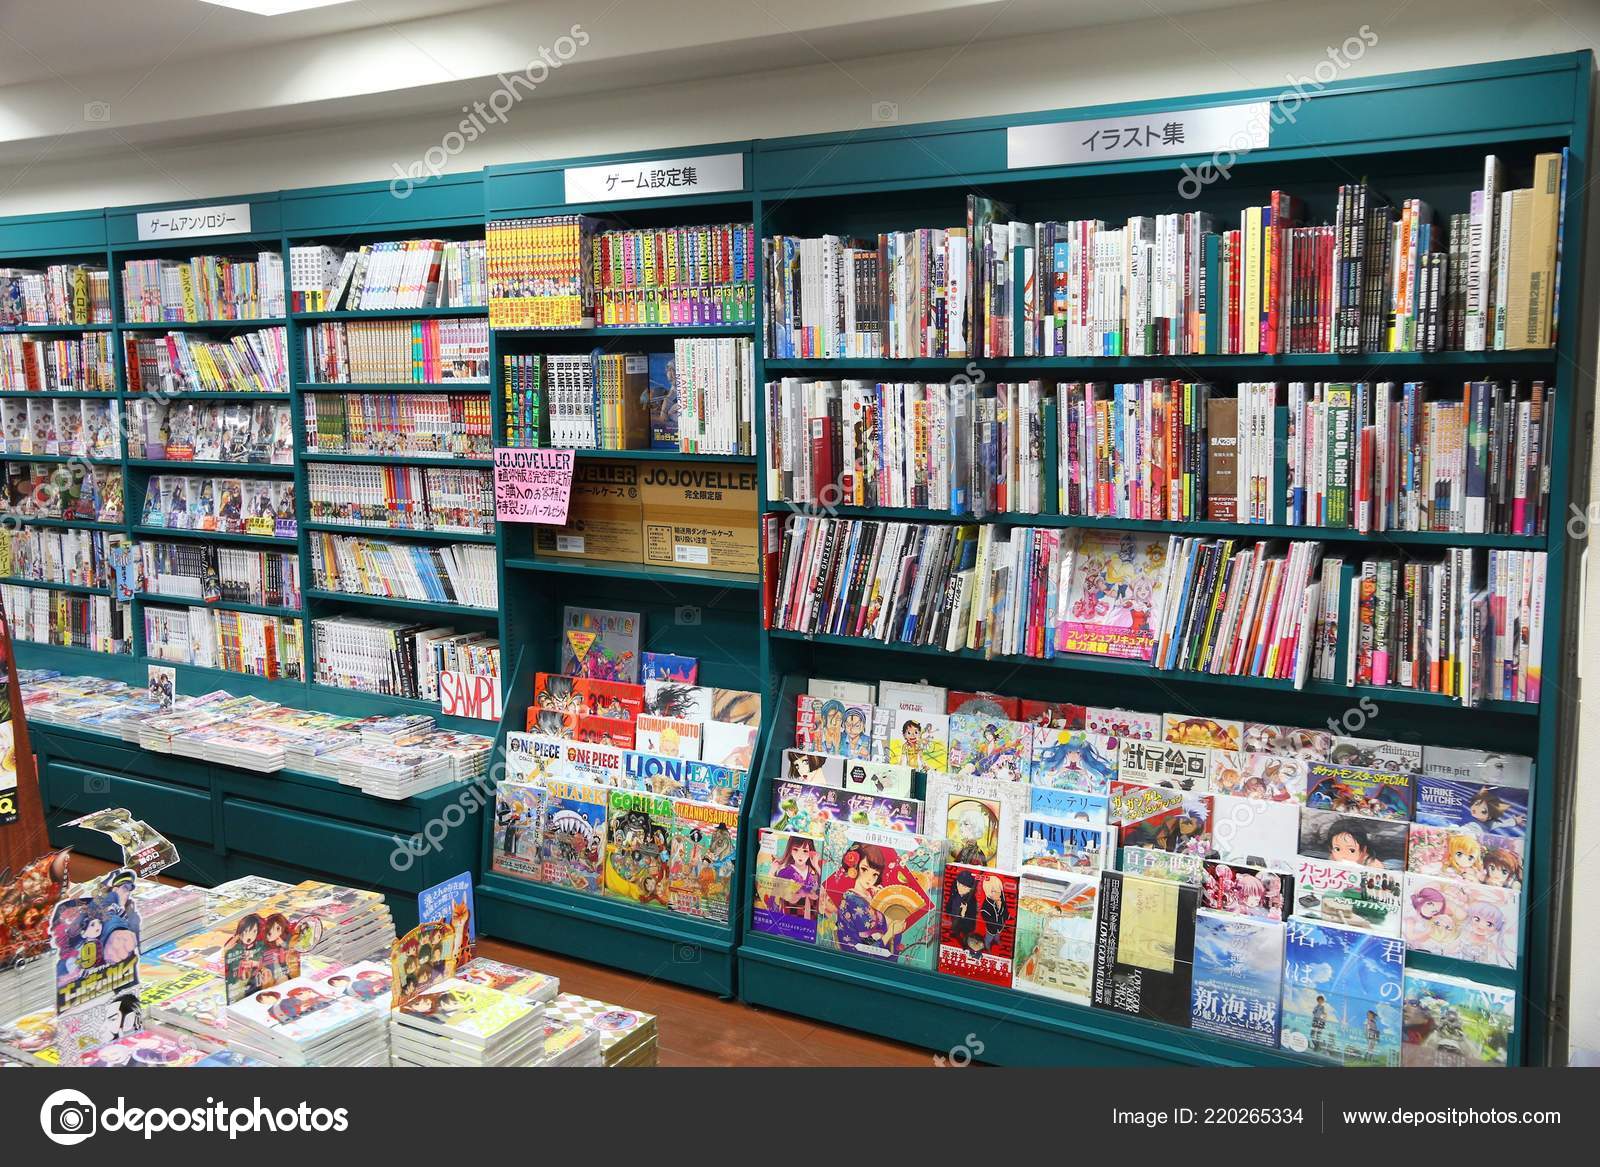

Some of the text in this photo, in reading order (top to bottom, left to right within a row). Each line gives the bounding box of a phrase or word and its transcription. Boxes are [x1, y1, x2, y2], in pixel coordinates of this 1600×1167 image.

[1081, 122, 1185, 154] イラスト集
[605, 166, 698, 191] ゲーム設定集
[150, 216, 236, 234] ゲームアンソロジー
[667, 235, 675, 266] DRAGON
[672, 290, 677, 298] 8
[683, 290, 688, 298] 9
[691, 289, 698, 298] 10
[702, 289, 708, 298] 11
[714, 289, 721, 298] 12
[724, 289, 732, 297] 13
[737, 289, 744, 298] 14
[557, 362, 565, 392] BLAME!
[565, 362, 573, 392] BLAME!
[573, 362, 581, 392] BLAME!
[582, 362, 590, 392] BLAME!
[1333, 410, 1348, 487] Wake Up, Girls!
[495, 452, 570, 470] JOJOVELLER
[496, 483, 567, 502] ご購入のお客様に
[684, 490, 723, 500] 完全限定版
[440, 670, 502, 722] SAMPL
[638, 716, 699, 739] UZUMAKI NARUTO
[511, 737, 560, 760] ONE PIECE
[567, 747, 619, 770] ONE PIECE
[626, 754, 681, 781] LION
[1312, 765, 1409, 787] ポケットモンスター SPECIAL
[1425, 763, 1470, 777] LITTER.pict
[548, 782, 605, 804] SHARK
[610, 790, 672, 816] GORILLA
[1036, 792, 1103, 809] バッテリー
[1127, 790, 1162, 809] ガンダム
[1421, 793, 1462, 806] WITCHES
[1422, 786, 1453, 799] STRIKE
[675, 801, 738, 828] TYRANNOSAURUS
[1024, 820, 1101, 849] HARVEST
[1095, 921, 1108, 1004] LOVE GOD MURDER
[1380, 939, 1402, 1001] 君の
[1193, 986, 1276, 1025] 新海誠
[1192, 1008, 1275, 1034] の魅力がここにある!
